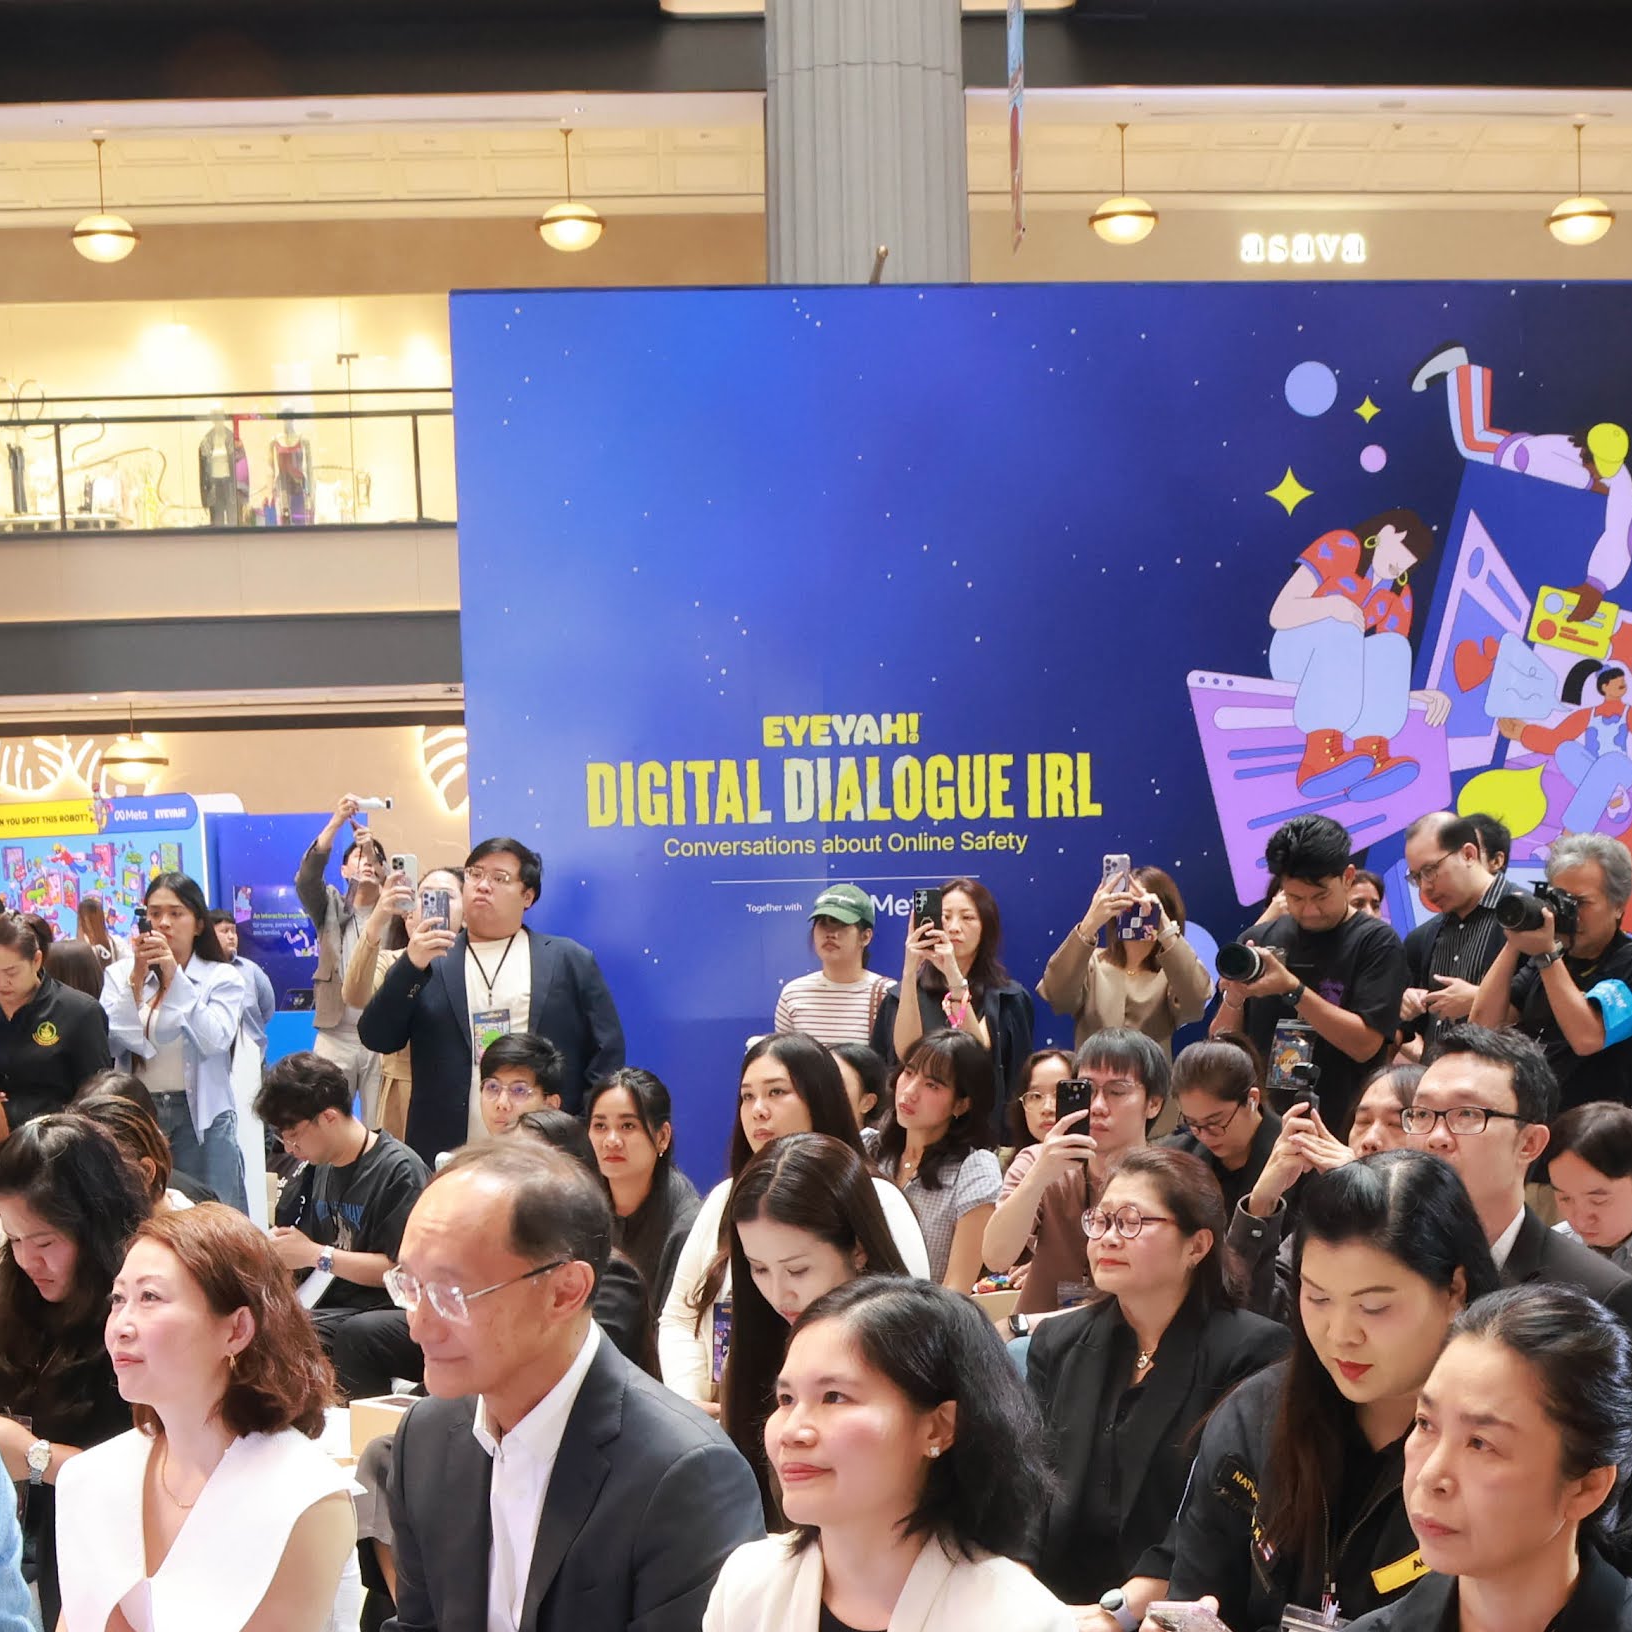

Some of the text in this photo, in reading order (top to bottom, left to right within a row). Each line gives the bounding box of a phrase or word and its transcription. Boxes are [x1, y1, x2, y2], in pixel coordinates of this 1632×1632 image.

[1240, 232, 1367, 263] asava
[763, 713, 919, 747] EYEYAH!
[586, 752, 1103, 827] DIGITAL DIALOGUE IRL
[126, 809, 148, 820] Meta
[664, 831, 1029, 857] Conversations about Online Safety
[746, 902, 803, 914] Together with
[869, 893, 915, 916] Me
